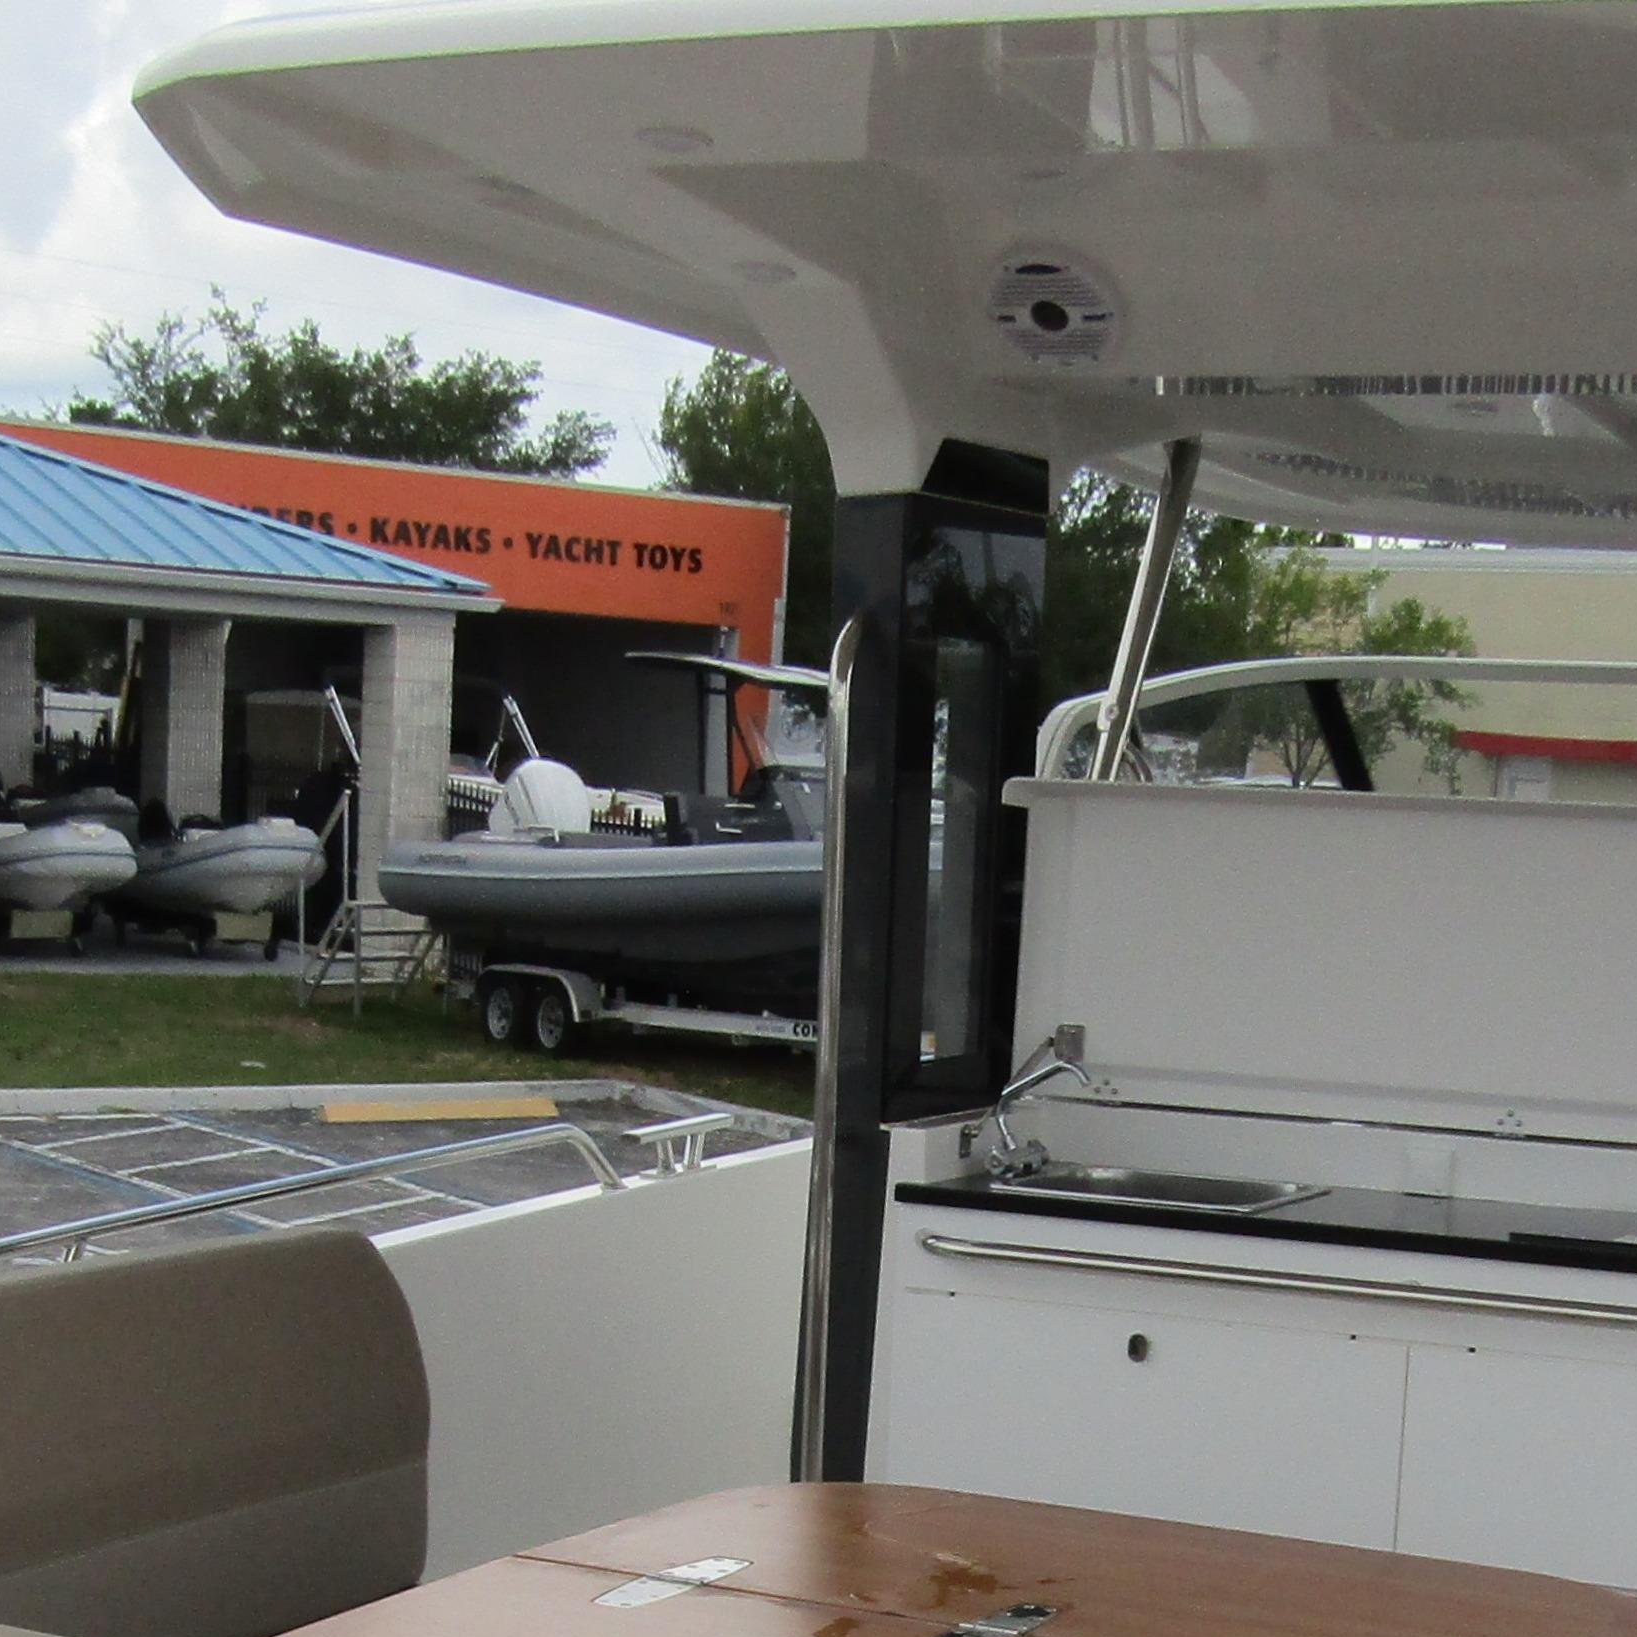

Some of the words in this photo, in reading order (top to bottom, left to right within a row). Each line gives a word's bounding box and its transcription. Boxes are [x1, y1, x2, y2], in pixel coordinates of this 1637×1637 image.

[369, 516, 491, 554] KAYAKS
[525, 532, 622, 566] YACHT
[632, 542, 703, 574] TOYS
